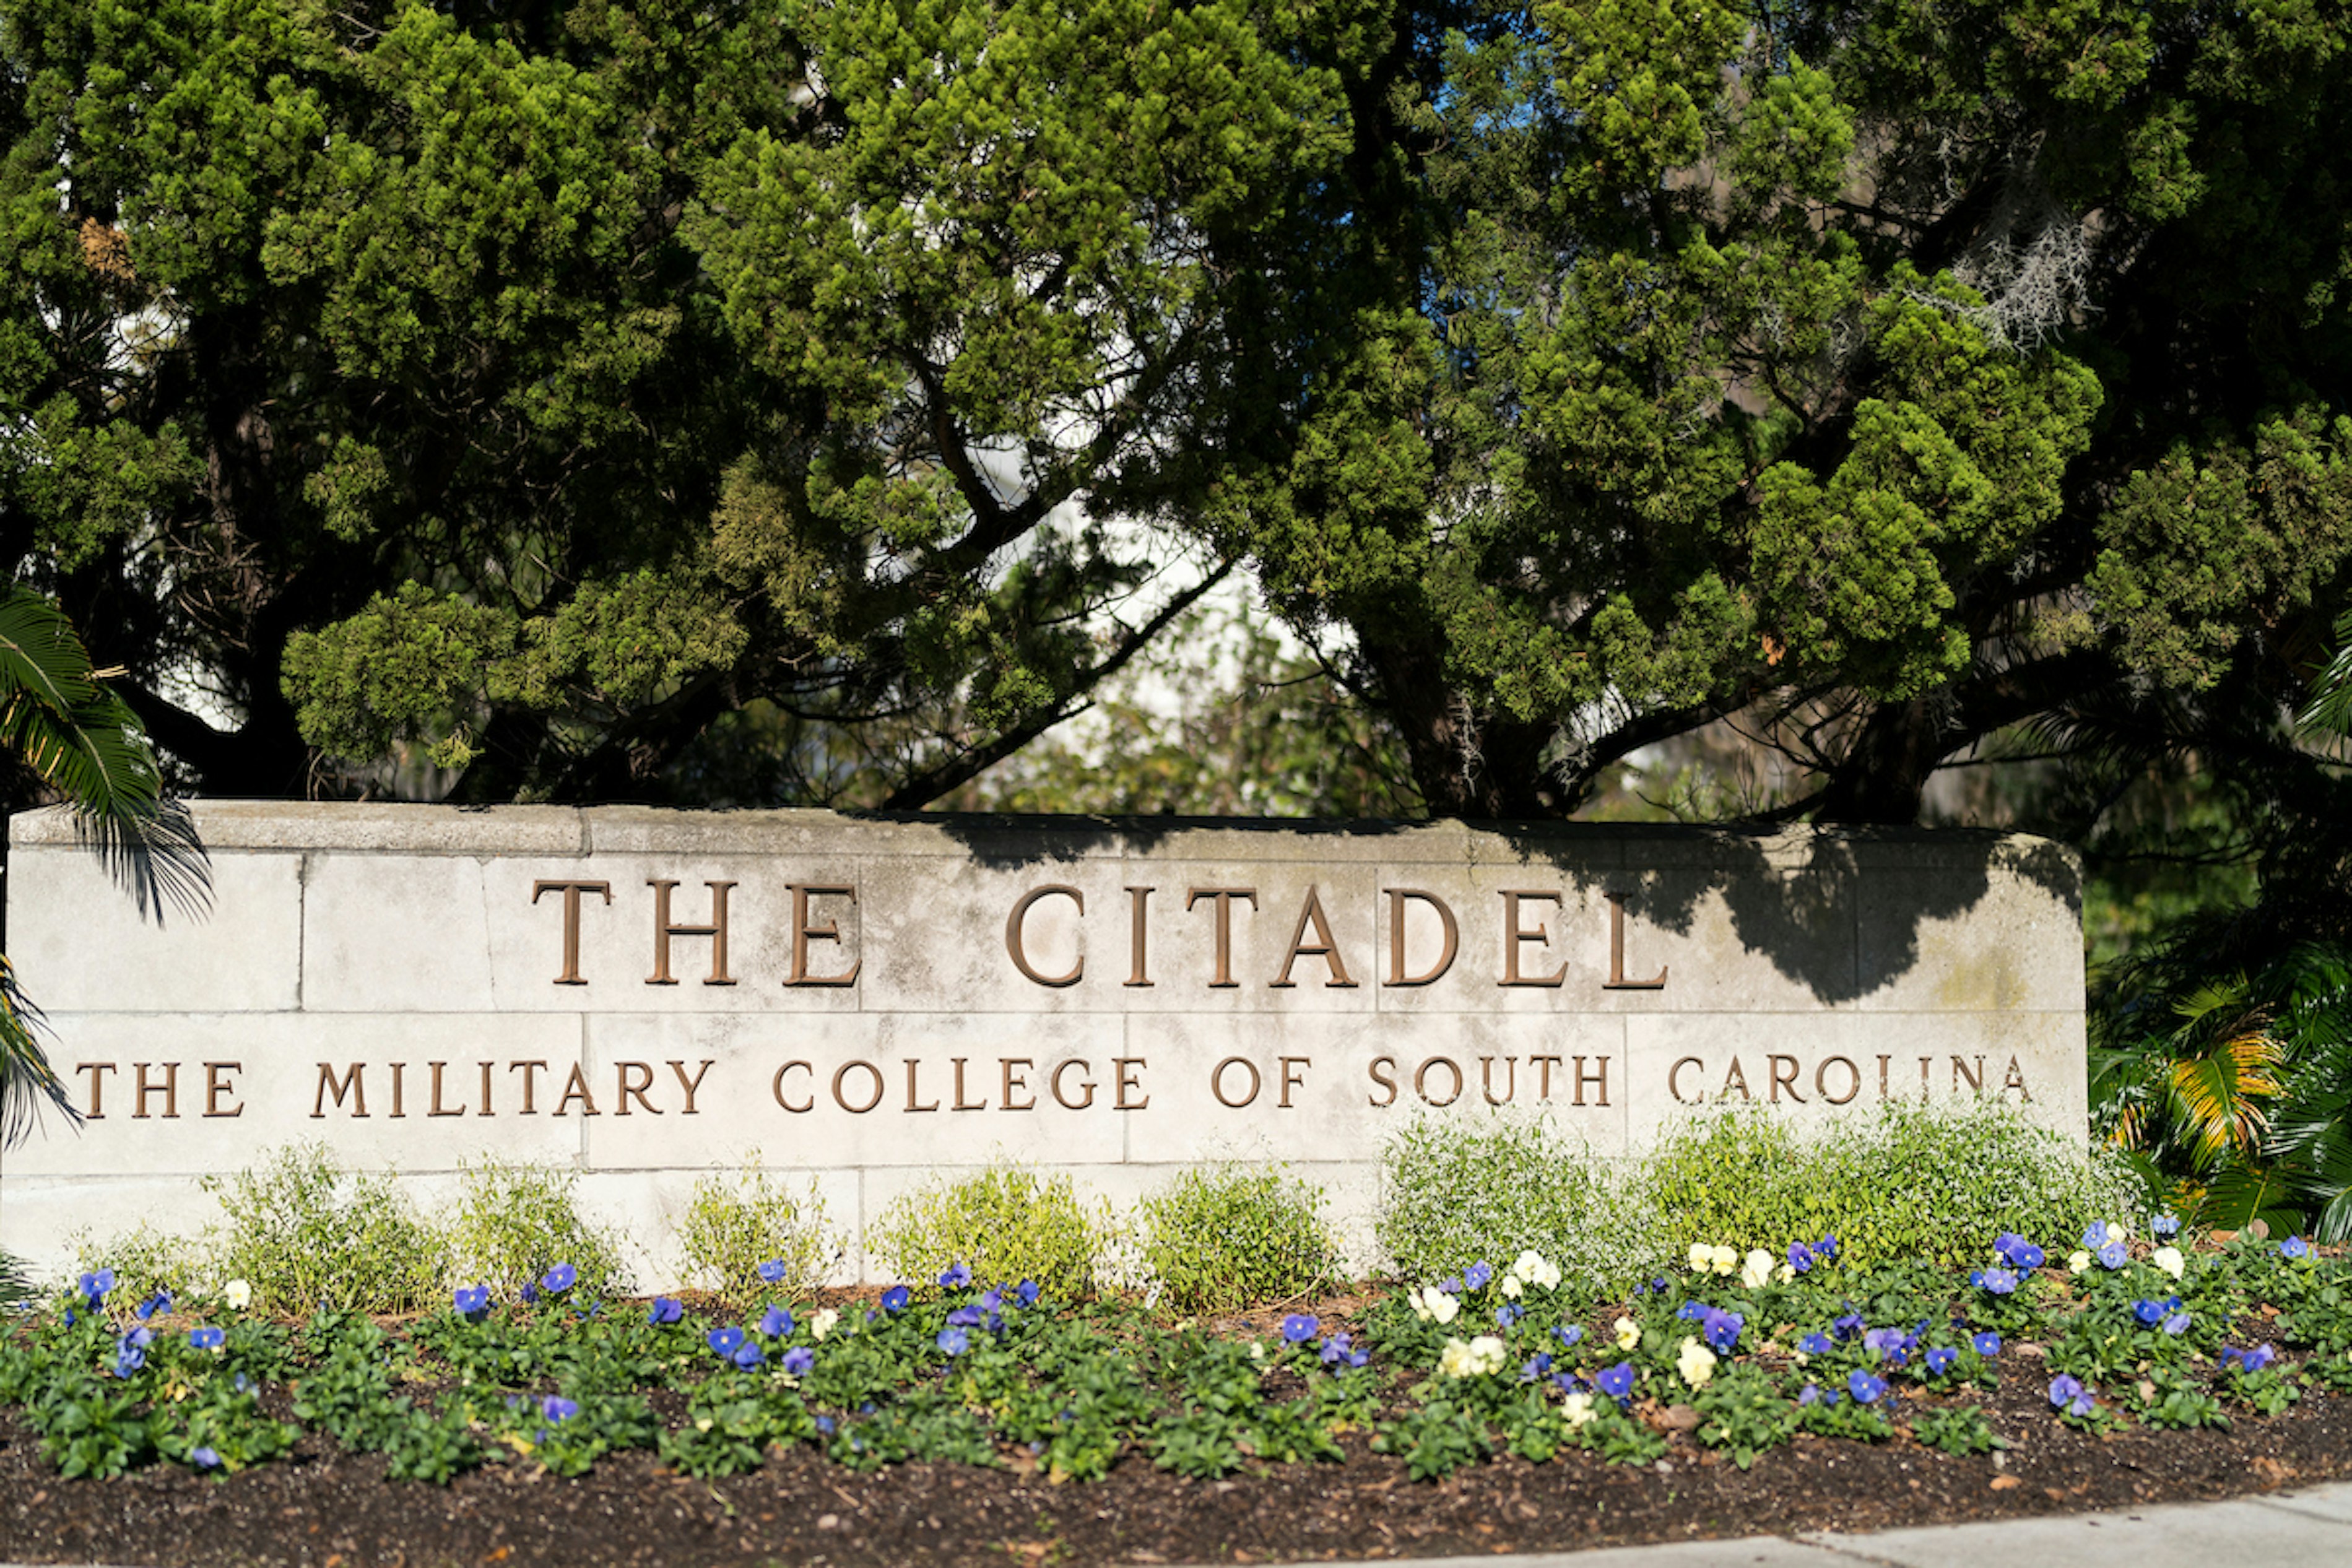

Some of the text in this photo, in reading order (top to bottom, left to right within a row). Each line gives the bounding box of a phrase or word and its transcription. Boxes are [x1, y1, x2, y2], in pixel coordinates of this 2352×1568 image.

[532, 878, 1670, 990] THE CITADEL
[76, 1060, 245, 1119] THE
[309, 1059, 715, 1118] MILITARY
[773, 1056, 1151, 1113] COLLEGE
[1210, 1055, 1313, 1109] OF
[1368, 1055, 1612, 1108] SOUTH
